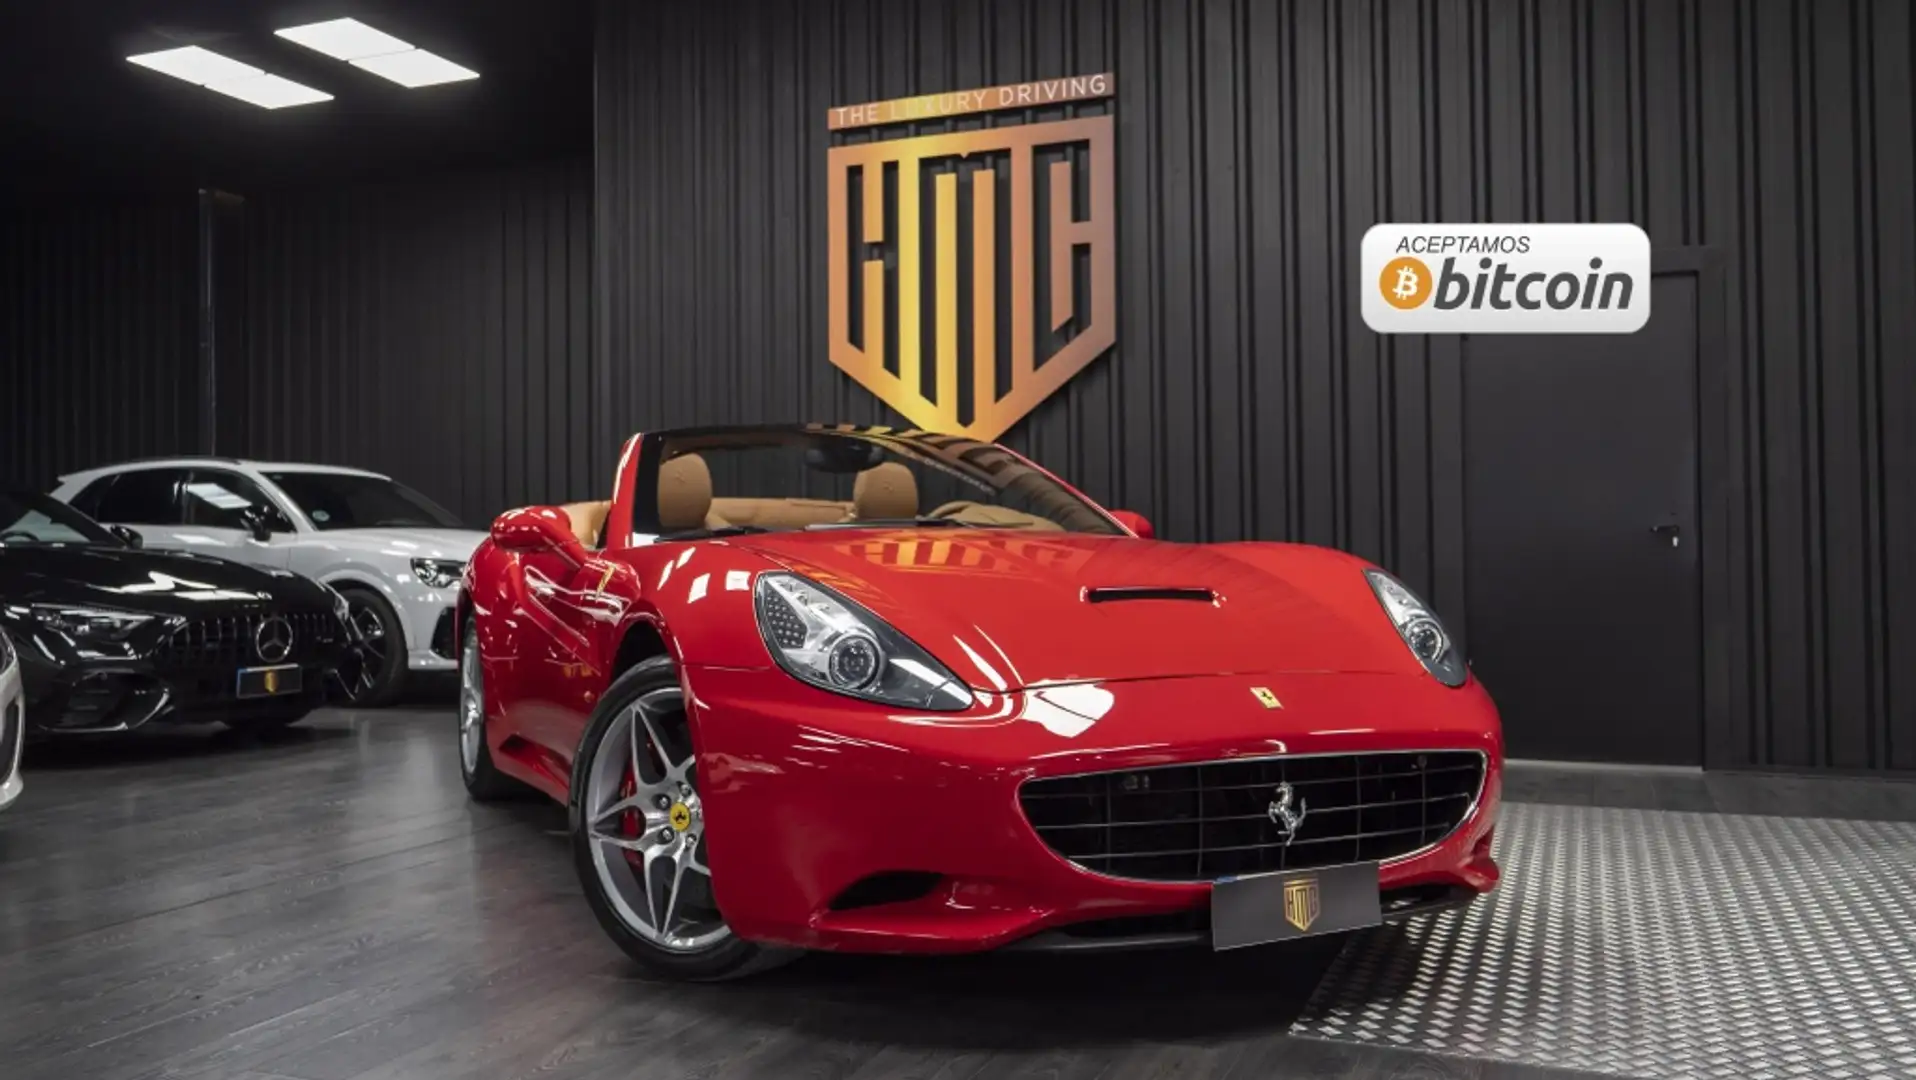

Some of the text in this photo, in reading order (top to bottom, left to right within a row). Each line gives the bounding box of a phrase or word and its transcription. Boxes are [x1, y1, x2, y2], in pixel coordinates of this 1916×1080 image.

[835, 74, 1107, 128] THE LUXURY DRIVING
